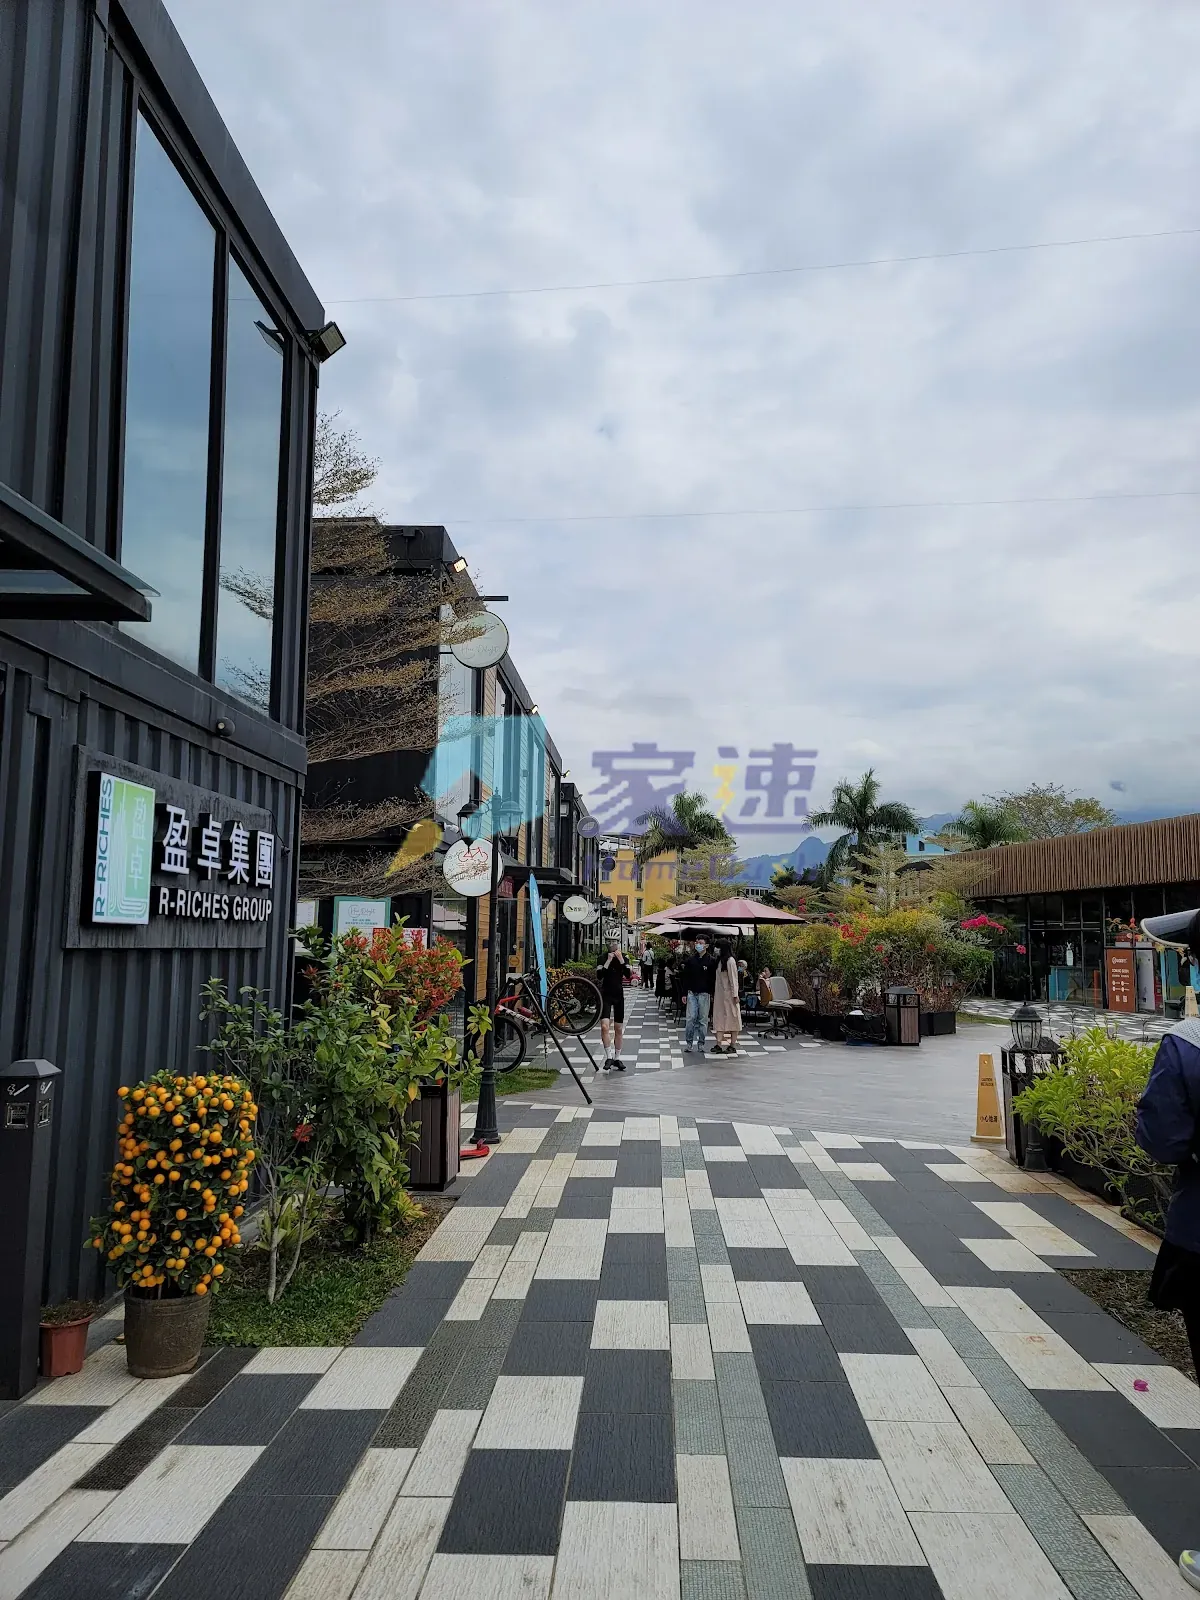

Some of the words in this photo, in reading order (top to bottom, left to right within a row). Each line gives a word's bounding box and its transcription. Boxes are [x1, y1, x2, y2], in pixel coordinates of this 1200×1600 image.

[95, 778, 113, 917] R-RICHES
[129, 797, 145, 890] 盈卓
[161, 804, 275, 889] 盈卓集團
[158, 887, 229, 920] R-RICHES
[232, 895, 273, 922] GROUP
